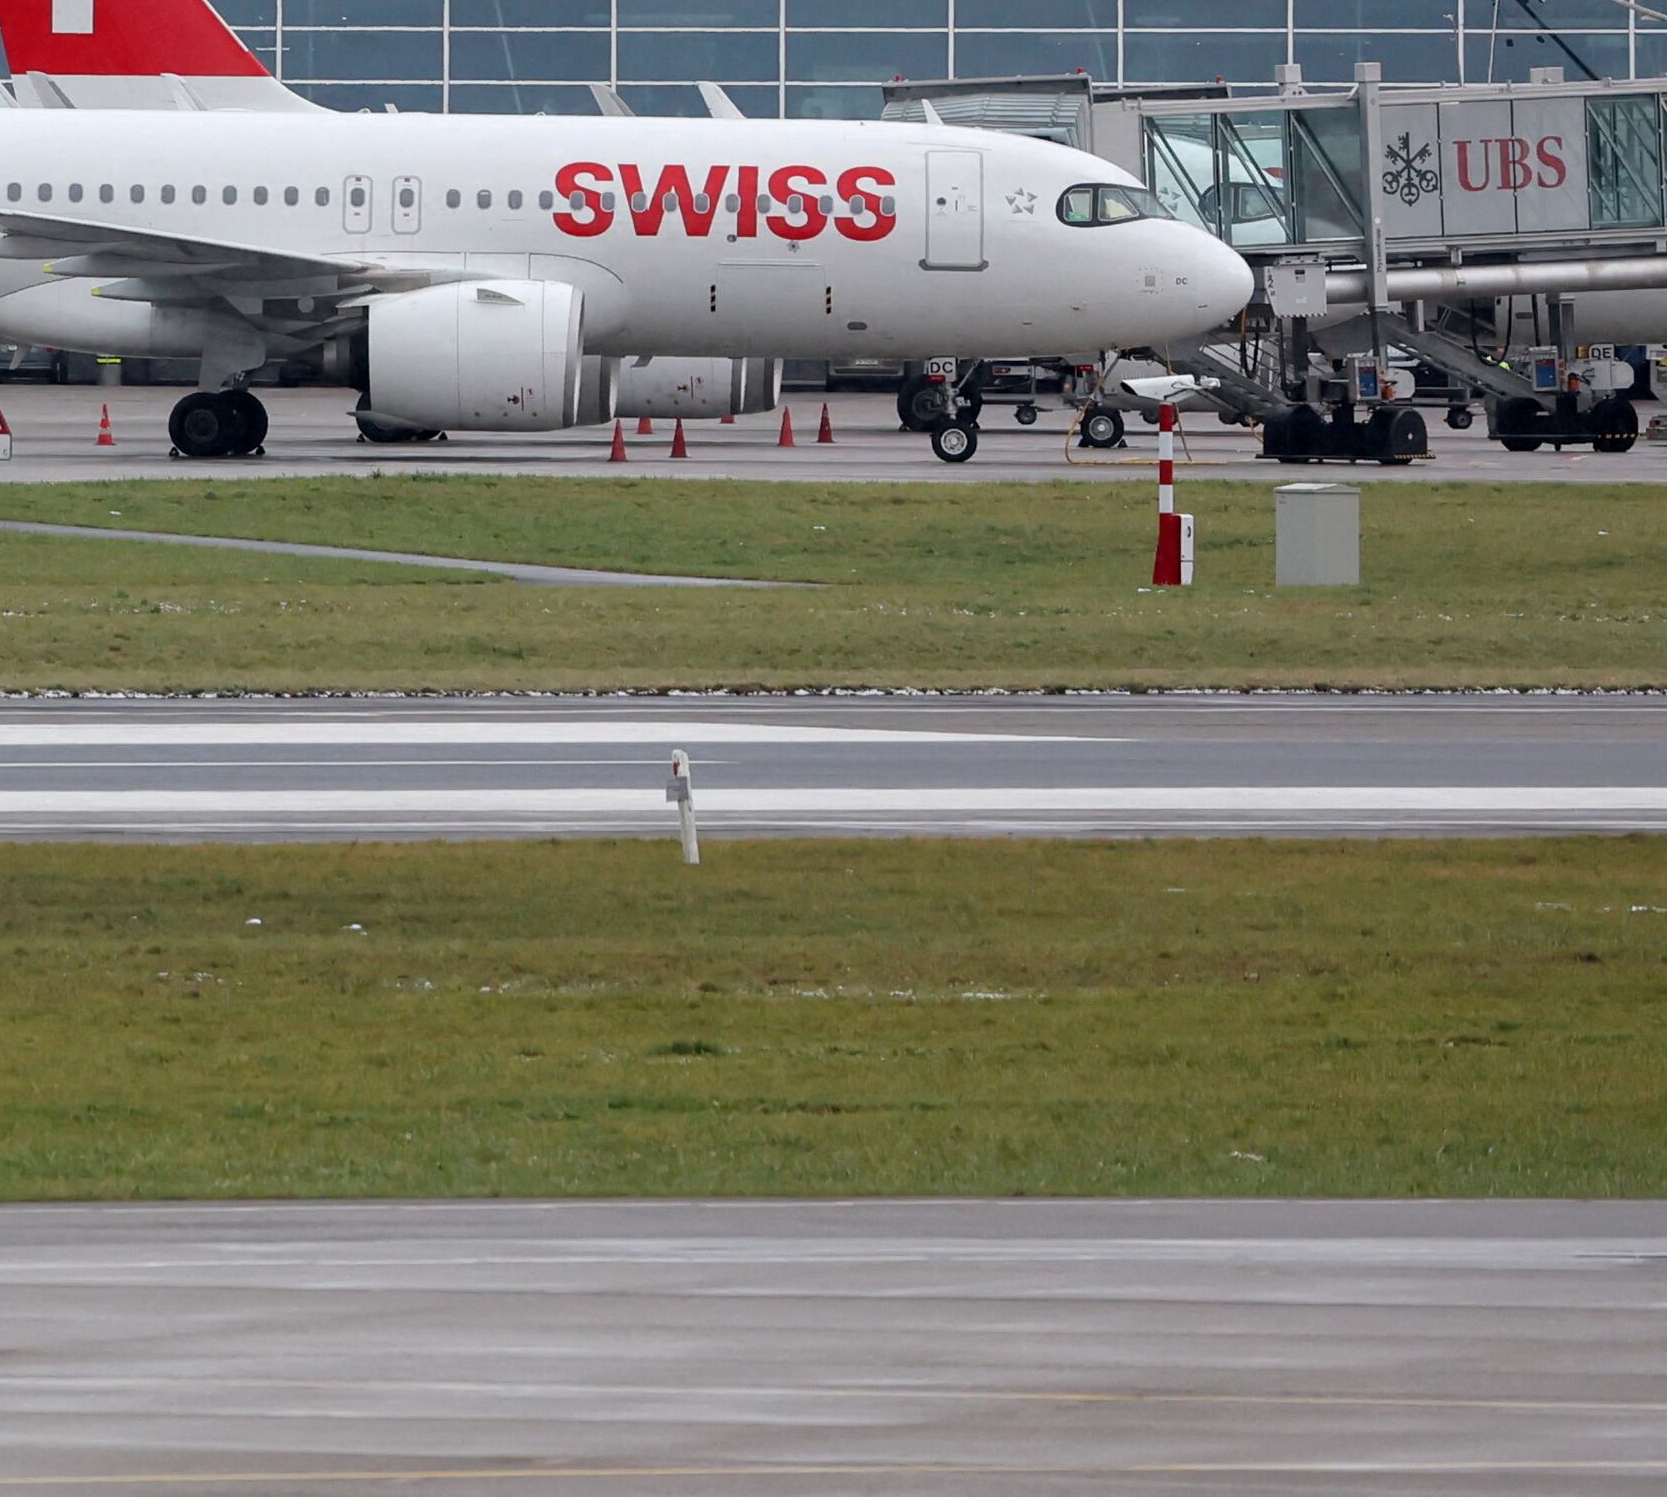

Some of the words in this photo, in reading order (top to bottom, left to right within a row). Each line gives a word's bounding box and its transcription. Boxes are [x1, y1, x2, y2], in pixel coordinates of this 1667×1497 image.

[1452, 136, 1567, 192] UBS
[553, 161, 897, 242] SWISS
[1175, 277, 1188, 285] DC
[930, 361, 954, 374] DC
